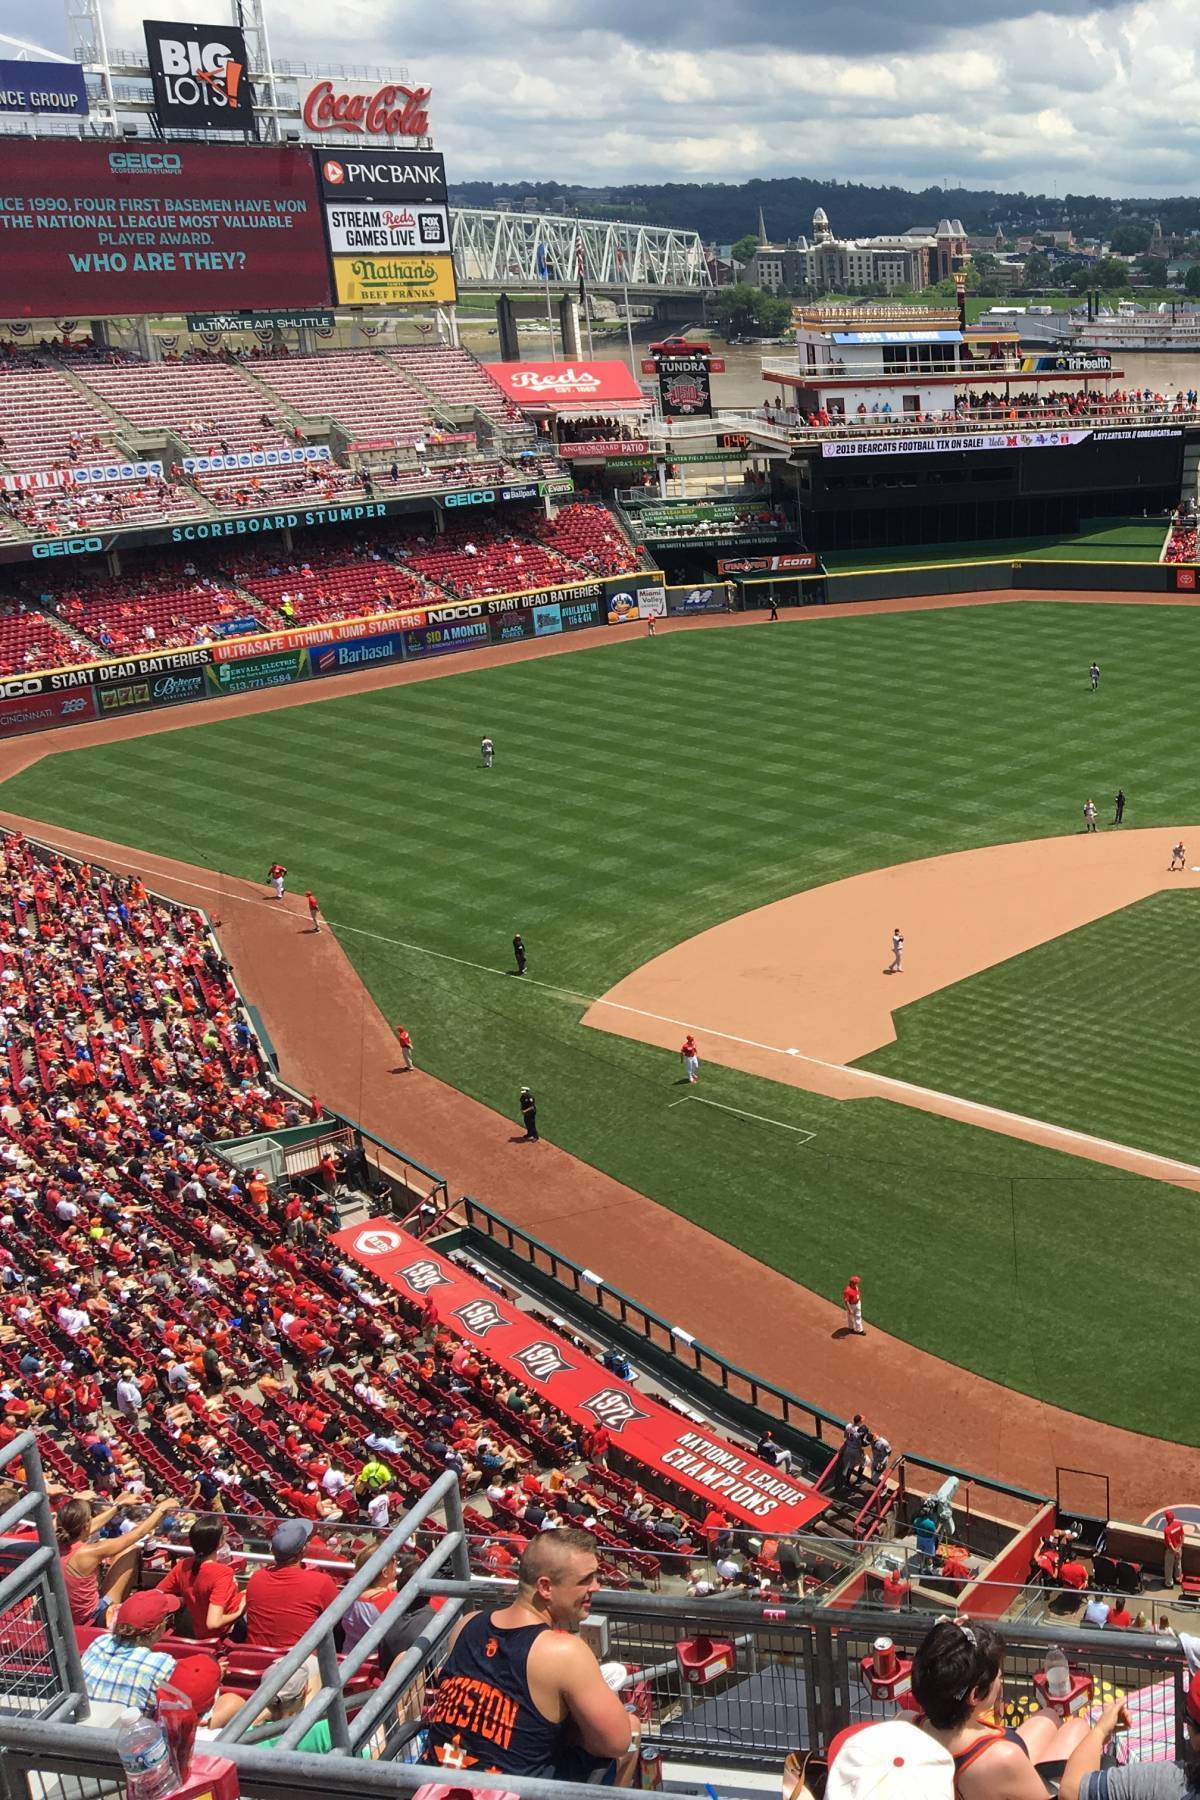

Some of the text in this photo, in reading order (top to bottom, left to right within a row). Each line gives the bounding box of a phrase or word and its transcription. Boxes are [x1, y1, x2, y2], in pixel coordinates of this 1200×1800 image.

[159, 39, 234, 78] BIG
[30, 92, 79, 108] GROUP
[303, 81, 432, 135] Coca-Cola
[108, 152, 182, 170] GEICO
[29, 197, 308, 213] 1990, FOUR FIRST BASEMEN HAVE WON
[1, 215, 293, 229] THE NATIONAL LEAGUE MOST VALUABLE
[332, 208, 416, 230] STREAM Reds
[422, 216, 439, 227] FOX
[99, 232, 214, 245] PLAYER AWARD.
[346, 229, 415, 247] GAMES LIVE
[424, 231, 441, 240] GO
[69, 252, 246, 272] WHO ARE THEY?
[361, 290, 435, 300] BEEF FRANKS
[192, 317, 330, 332] ULTIMATE AIR SHUTTLE
[660, 362, 706, 372] TUNDRA
[1067, 357, 1111, 370] TriHealth
[511, 368, 602, 391] Reds
[621, 443, 644, 452] PATIO
[836, 438, 983, 455] 2019 BEARCATS FOOTBALL TIX ON SALE!
[511, 488, 537, 499] Ballpark
[548, 481, 571, 493] Evans
[33, 490, 496, 558] GEICO SCOREBOARD STUMPER GEICO
[428, 606, 482, 624] NOCO
[488, 597, 519, 613] START
[523, 593, 548, 609] DEAD
[443, 631, 449, 641] A
[452, 622, 487, 638] MONTH
[502, 626, 522, 634] BLACK
[218, 637, 284, 660] ULTRASAFE
[288, 631, 333, 648] LITHIUM
[336, 624, 366, 640] JUMP
[339, 642, 393, 665] Barbasol
[51, 669, 95, 689] START
[99, 663, 136, 681] DEAD
[139, 650, 212, 674] BATTERIES.
[262, 658, 297, 669] ELECTRIC
[402, 1261, 440, 1289] 1939
[459, 1301, 498, 1331] 1961
[519, 1343, 561, 1376] 1970
[588, 1391, 634, 1425] 1972
[676, 1432, 806, 1506] NATIONAL LEAGUE
[661, 1448, 779, 1516] CHAMPIONS
